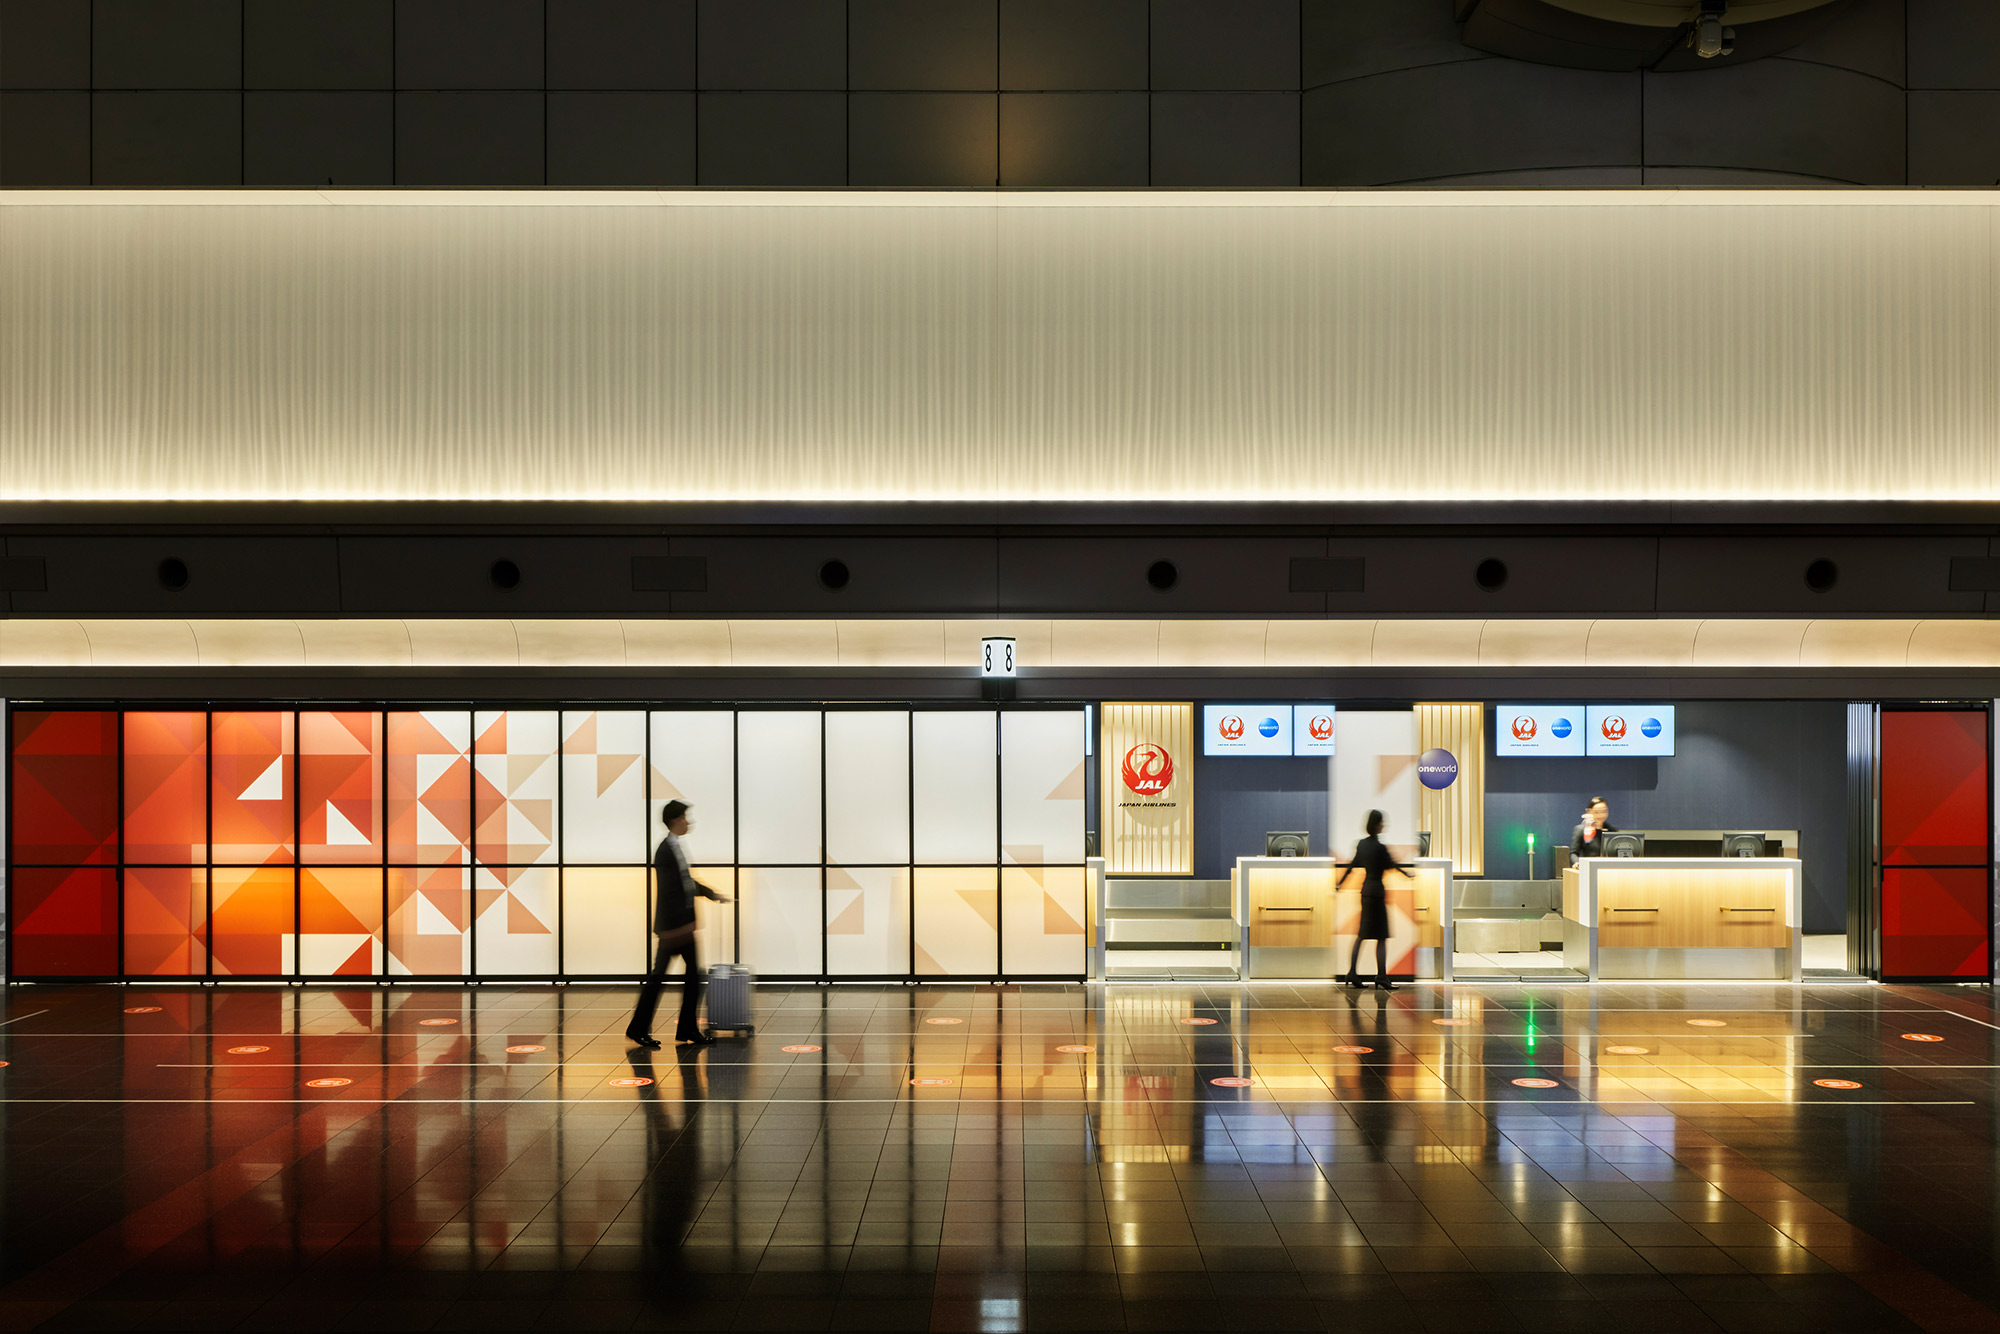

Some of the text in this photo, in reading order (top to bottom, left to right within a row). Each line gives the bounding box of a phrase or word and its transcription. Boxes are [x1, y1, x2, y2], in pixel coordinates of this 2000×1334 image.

[985, 643, 992, 672] 8
[1005, 643, 1012, 672] 8
[1418, 764, 1457, 773] oneworld
[1135, 780, 1164, 789] JAL
